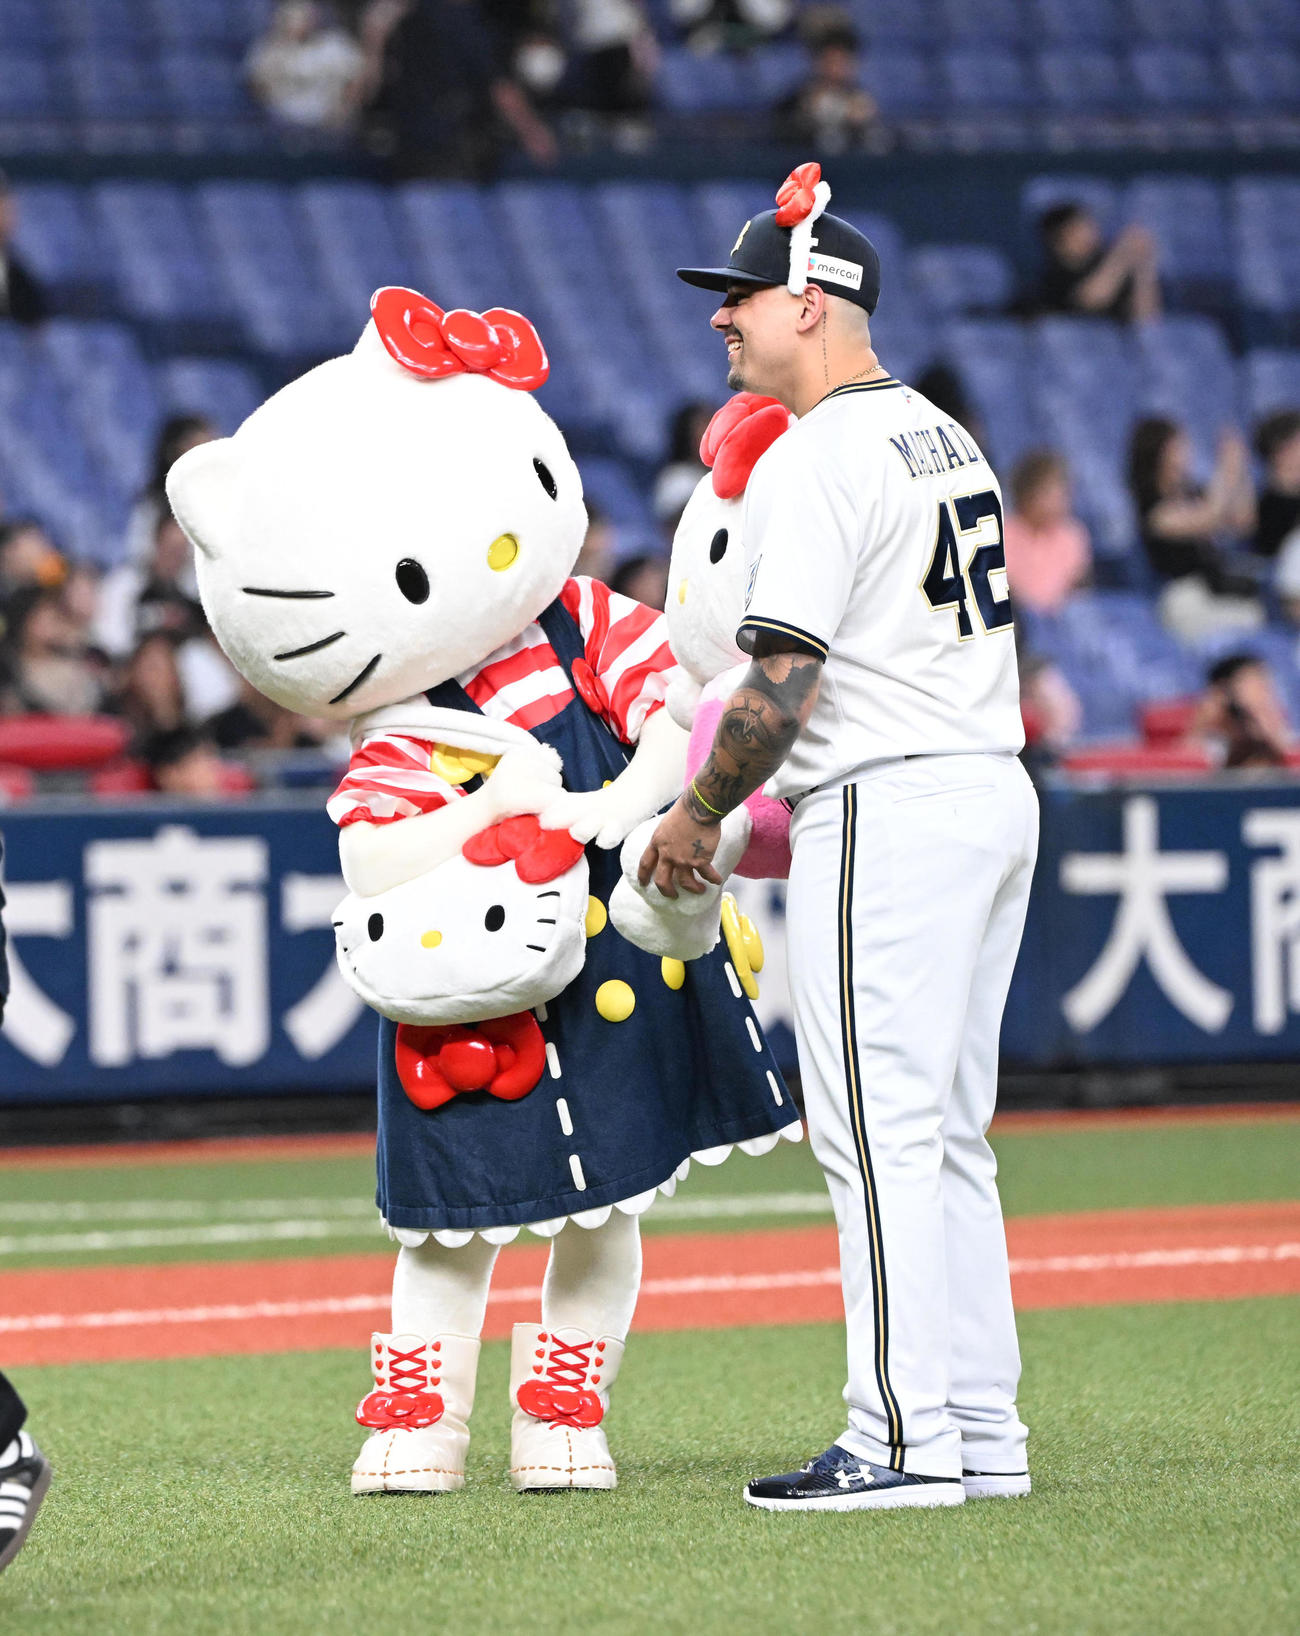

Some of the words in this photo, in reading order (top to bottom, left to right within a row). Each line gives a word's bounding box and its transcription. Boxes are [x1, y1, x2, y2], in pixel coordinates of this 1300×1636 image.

[817, 262, 861, 282] mercari
[889, 424, 985, 480] MHAD
[919, 488, 1014, 642] 42
